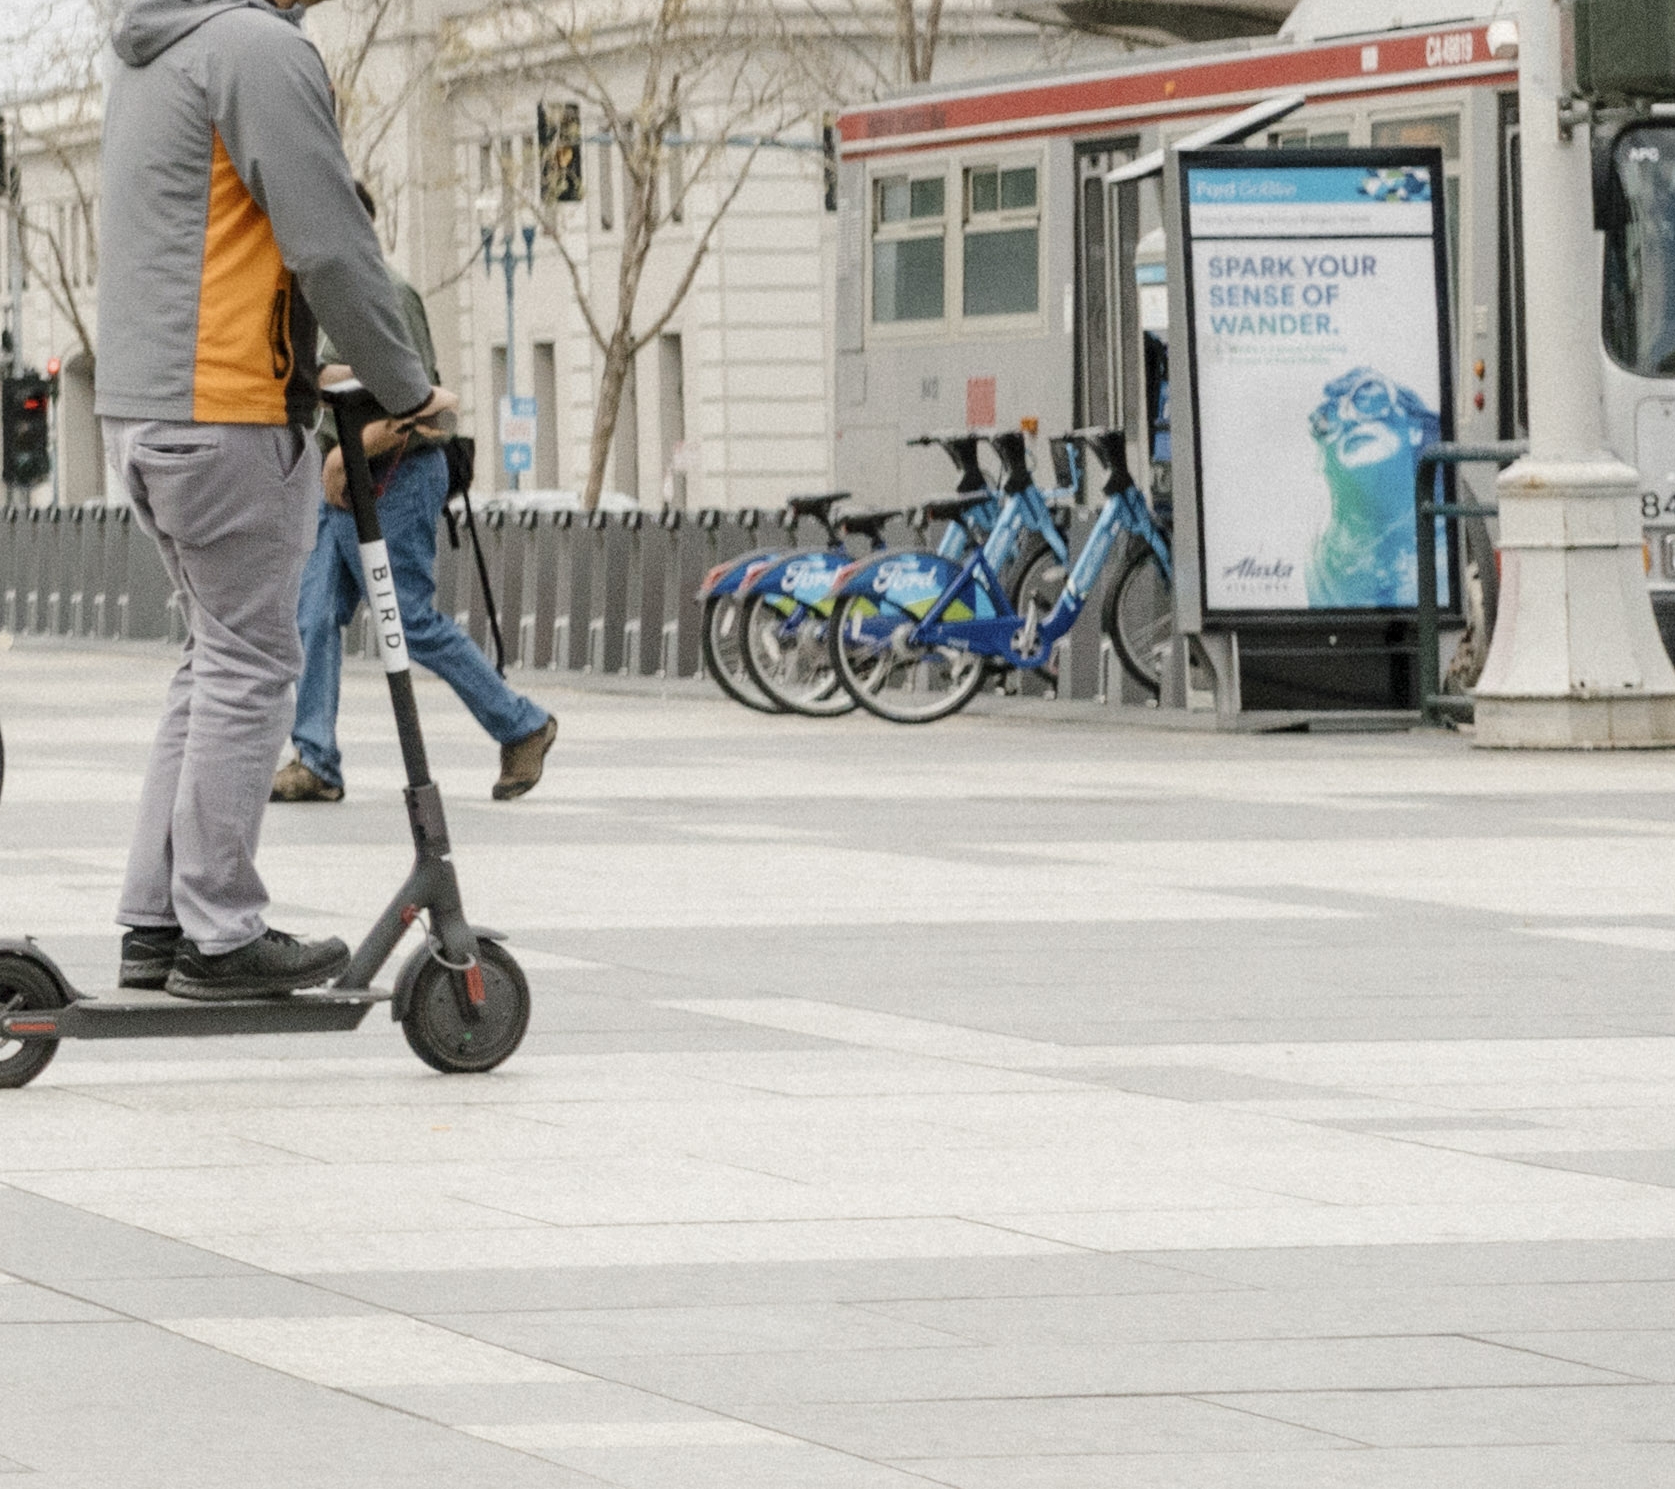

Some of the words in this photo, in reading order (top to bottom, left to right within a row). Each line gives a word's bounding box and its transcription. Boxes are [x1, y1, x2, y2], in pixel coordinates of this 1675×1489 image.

[1208, 255, 1295, 278] SPARK
[1303, 254, 1377, 277] YOUR
[1209, 285, 1295, 308] SENSE
[1302, 284, 1340, 307] OF
[1211, 313, 1340, 336] WANDER.
[872, 560, 938, 593] Ford
[372, 564, 401, 649] BIRD
